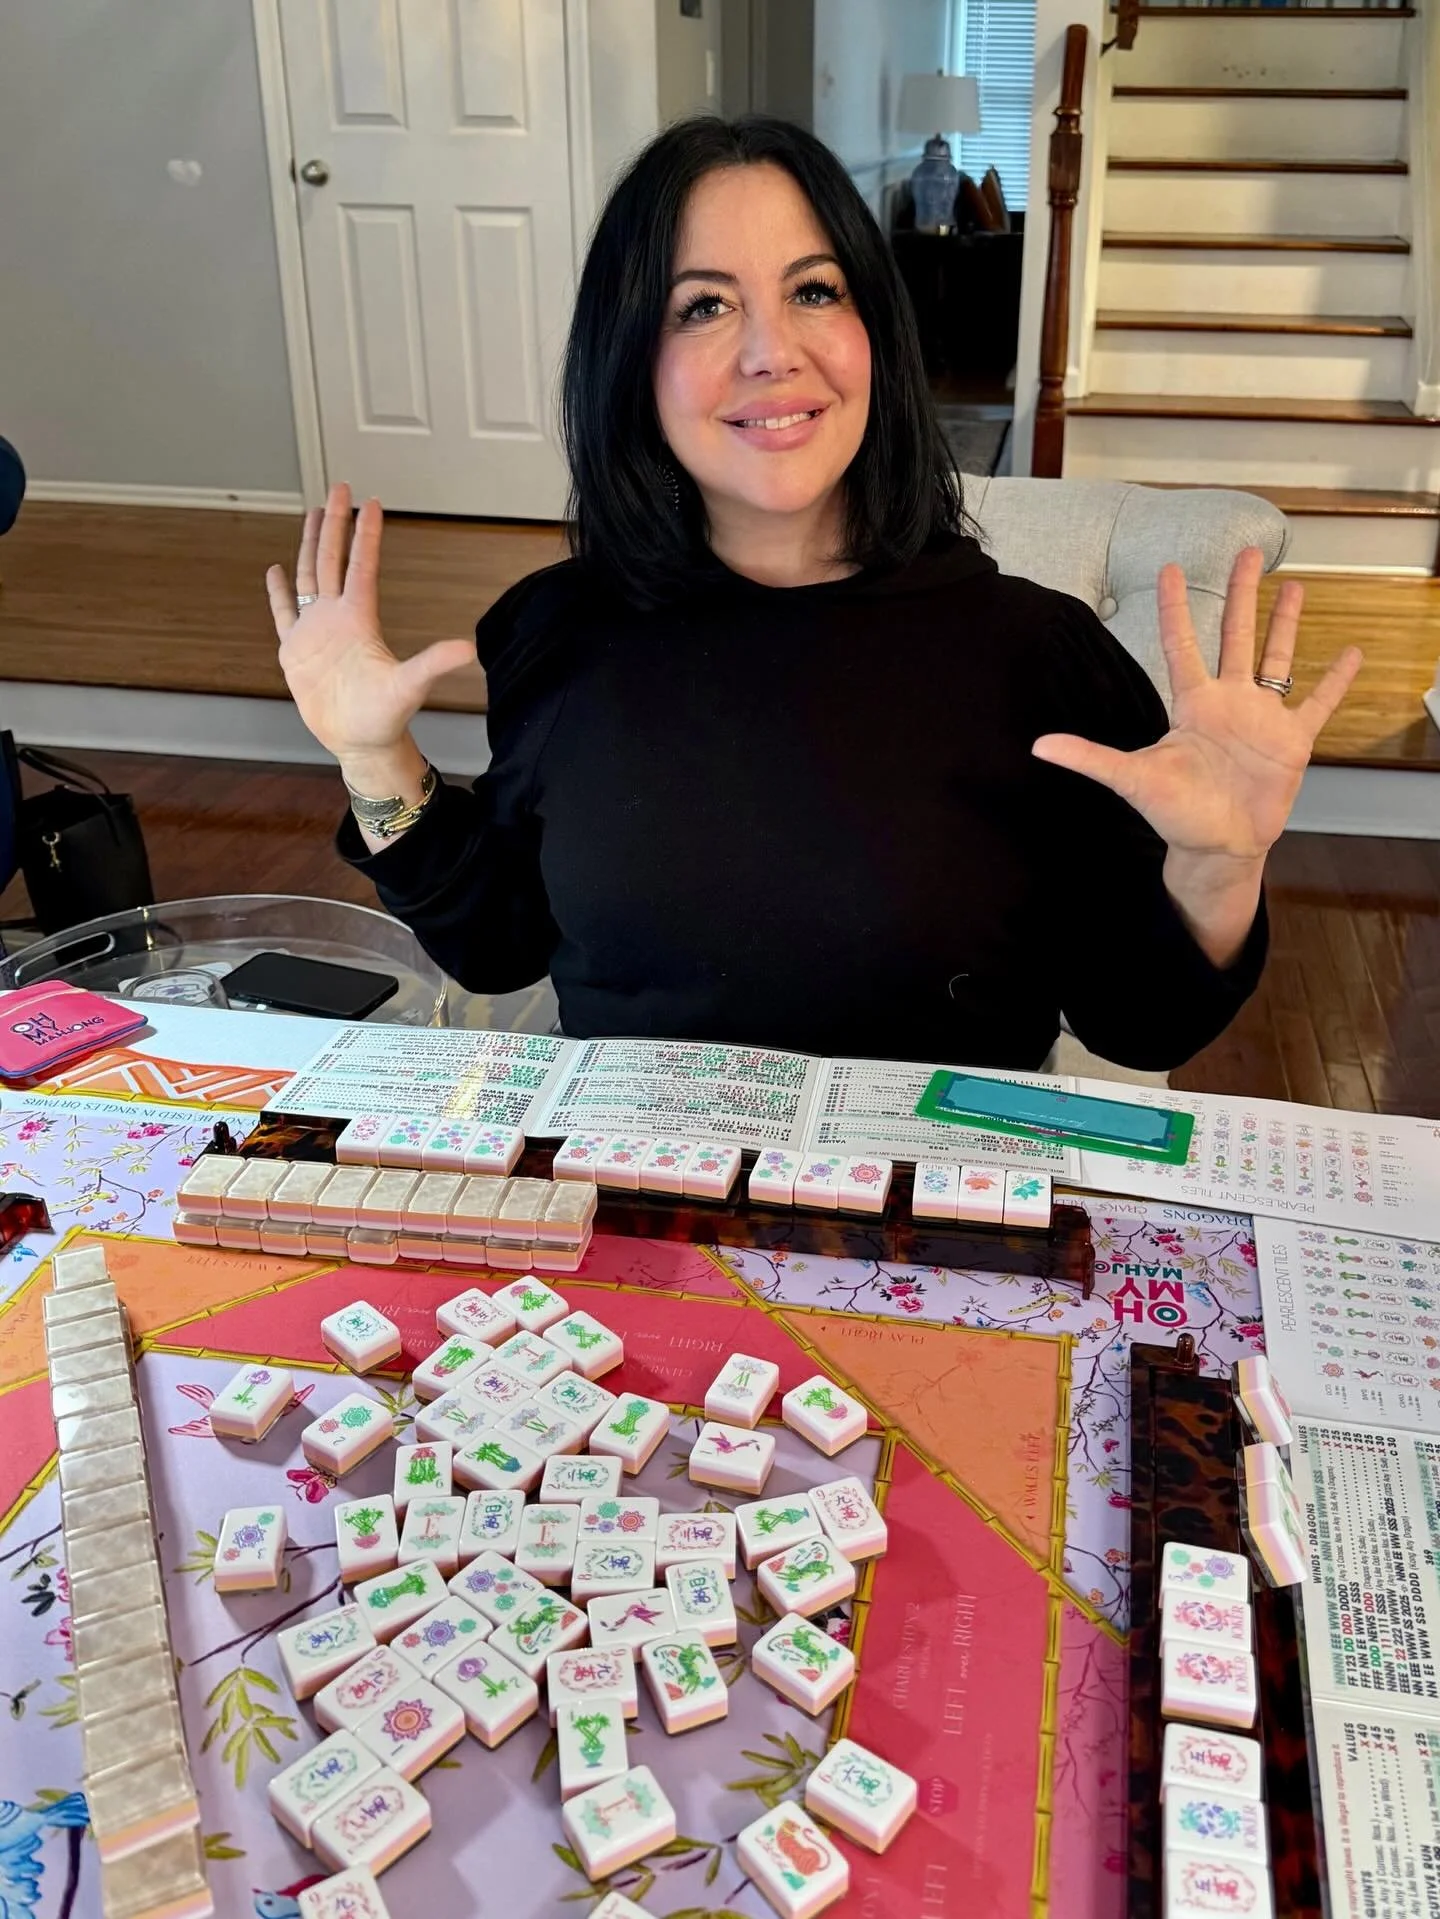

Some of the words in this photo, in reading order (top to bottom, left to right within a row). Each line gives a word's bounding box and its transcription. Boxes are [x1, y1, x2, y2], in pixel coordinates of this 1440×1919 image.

[12, 1012, 53, 1033] OH
[35, 1016, 105, 1045] MAHJONG
[23, 1097, 58, 1110] PAIRS
[86, 1103, 139, 1116] SINGLES
[1181, 1186, 1213, 1199] TILES
[1219, 1191, 1315, 1213] PEARLESCENT
[1099, 1203, 1148, 1215] CRAKS
[1162, 1208, 1252, 1228] DRAGONS
[1272, 1243, 1288, 1264] TILES
[1114, 1276, 1184, 1304] MY
[1273, 1268, 1296, 1331] PEARLESCENT
[1114, 1299, 1188, 1328] OH
[1298, 1425, 1308, 1453] VALUES
[1320, 1428, 1330, 1438] 25
[1331, 1430, 1341, 1440] 25
[1342, 1431, 1352, 1441] 25
[1354, 1432, 1363, 1443] 25
[1365, 1434, 1374, 1444] 25
[1375, 1436, 1385, 1446] 30
[1386, 1437, 1397, 1448] 30
[1424, 1442, 1435, 1453] 25
[1384, 1497, 1397, 1516] 2025
[1305, 1503, 1318, 1545] DRAGONS
[1387, 1517, 1399, 1531] SSS
[1320, 1541, 1333, 1560] NNN
[1390, 1533, 1401, 1549] WW
[1393, 1551, 1404, 1559] EE
[1423, 1549, 1435, 1565] 369
[1311, 1554, 1322, 1584] WINDS
[1394, 1562, 1407, 1582] NNN
[1349, 1581, 1361, 1603] SSSS
[1408, 1572, 1423, 1602] DDDD
[1338, 1584, 1350, 1611] DDDD
[1363, 1591, 1375, 1613] DDD
[1375, 1593, 1387, 1615] SSSS
[1386, 1588, 1402, 1624] WWWW
[1399, 1595, 1412, 1616] 2025
[950, 1591, 977, 1647] RIGHT
[1230, 1605, 1245, 1641] JOKER
[1340, 1614, 1353, 1636] DDD
[1353, 1606, 1366, 1635] WWW
[1402, 1617, 1414, 1631] SS
[1414, 1606, 1426, 1625] SSS
[1366, 1614, 1379, 1642] NEWS
[1392, 1627, 1404, 1646] 222
[1343, 1638, 1356, 1652] DD
[1356, 1637, 1367, 1650] EE
[1404, 1630, 1418, 1659] WWW
[1417, 1628, 1432, 1659] WWW
[1345, 1655, 1357, 1671] 123
[1358, 1652, 1370, 1669] NN
[1369, 1645, 1381, 1667] DDD
[1395, 1648, 1406, 1660] 22
[1235, 1658, 1250, 1695] JOKER
[1383, 1660, 1398, 1691] NNNN
[1408, 1662, 1420, 1678] EEE
[1423, 1663, 1436, 1676] EE
[1346, 1676, 1359, 1687] FF
[1359, 1671, 1372, 1688] FFF
[1372, 1669, 1385, 1690] FFFF
[1398, 1671, 1411, 1693] EEEE
[1411, 1679, 1424, 1696] NN
[1426, 1680, 1440, 1698] NN
[1357, 1723, 1368, 1737] 40
[1371, 1726, 1381, 1740] 45
[1384, 1727, 1396, 1742] 45
[1415, 1732, 1427, 1746] 25
[1344, 1722, 1358, 1761] VALUES
[1360, 1739, 1370, 1747] X
[1375, 1741, 1385, 1749] X
[1388, 1743, 1398, 1751] X
[1419, 1748, 1429, 1757] X
[929, 1777, 945, 1815] STOP
[1242, 1804, 1259, 1850] JOKER
[1419, 1844, 1433, 1869] RUN
